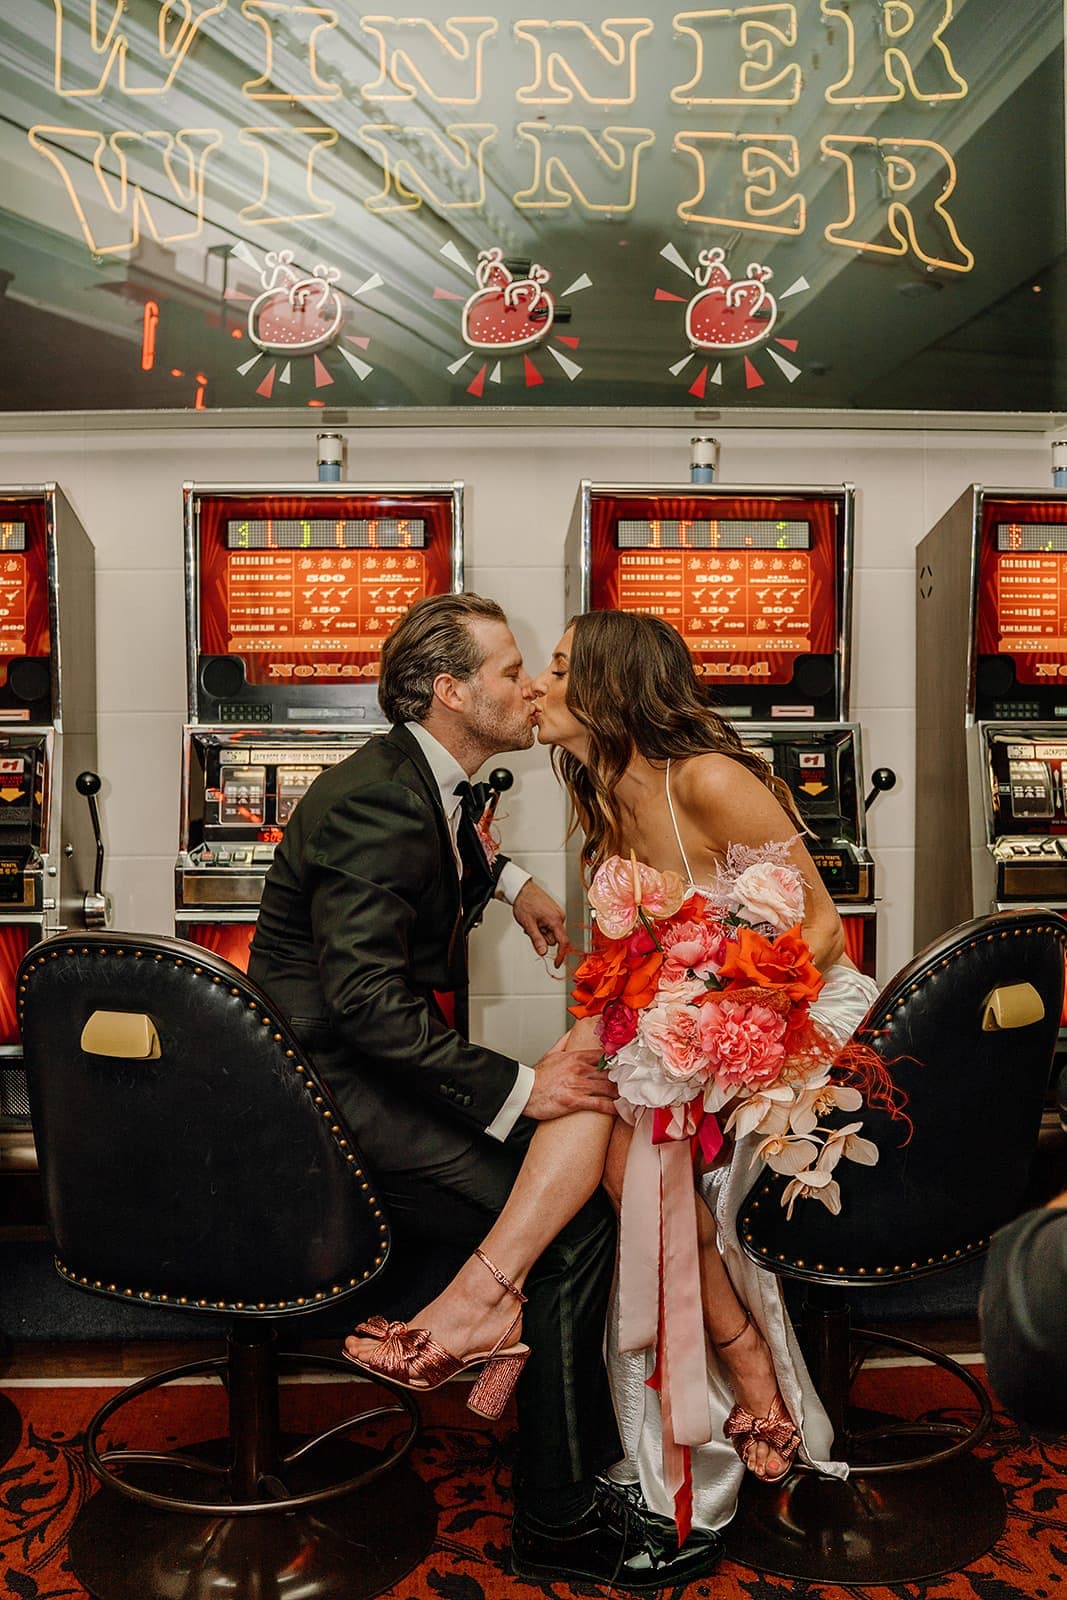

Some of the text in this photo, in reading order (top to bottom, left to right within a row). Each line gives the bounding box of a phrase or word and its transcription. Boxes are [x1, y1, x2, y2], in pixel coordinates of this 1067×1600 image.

[52, 0, 969, 106] WINNER
[28, 121, 976, 273] WINNER
[305, 573, 346, 583] 500
[694, 574, 735, 584] 500
[310, 606, 342, 614] 150
[699, 606, 731, 614] 150
[268, 662, 381, 677] NoMad
[693, 662, 771, 676] Mad
